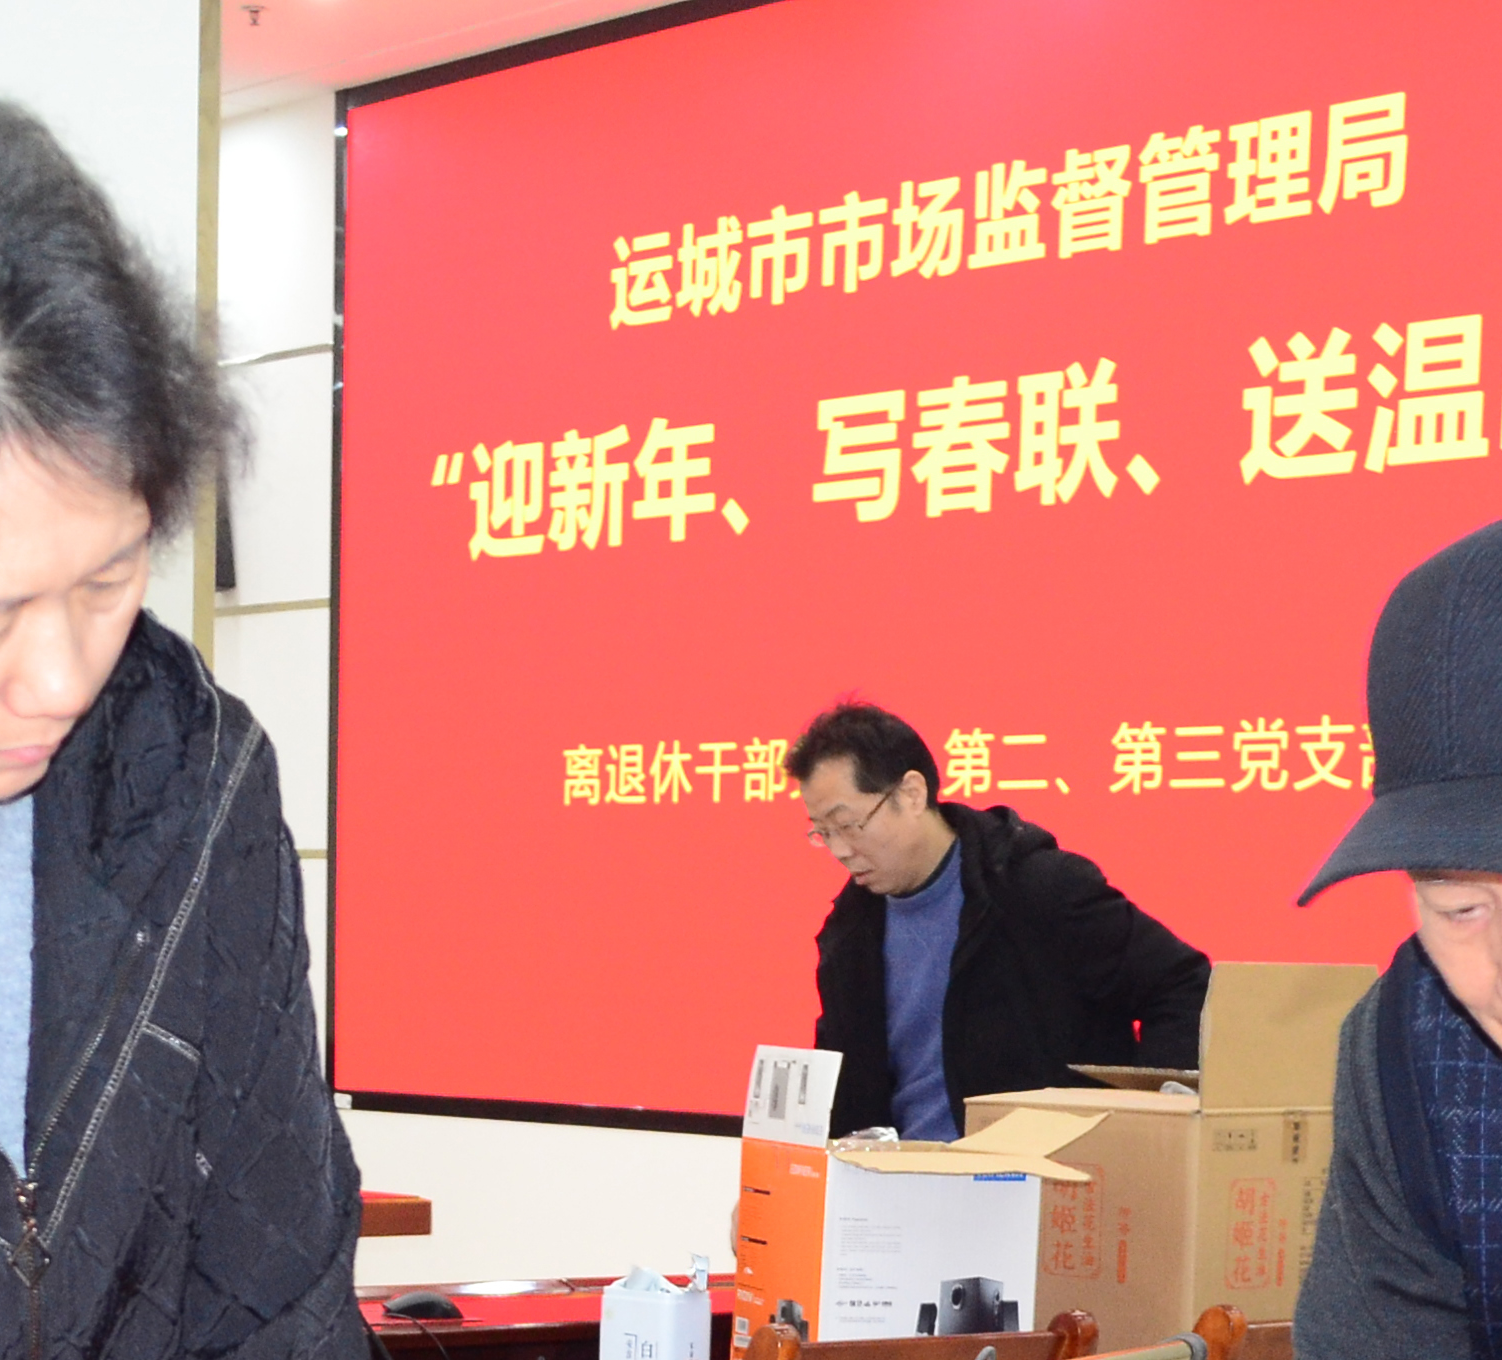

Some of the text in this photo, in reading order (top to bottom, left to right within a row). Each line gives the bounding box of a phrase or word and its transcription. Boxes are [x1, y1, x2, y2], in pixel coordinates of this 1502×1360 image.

[610, 91, 1410, 331] 运城市市场监督管理局
